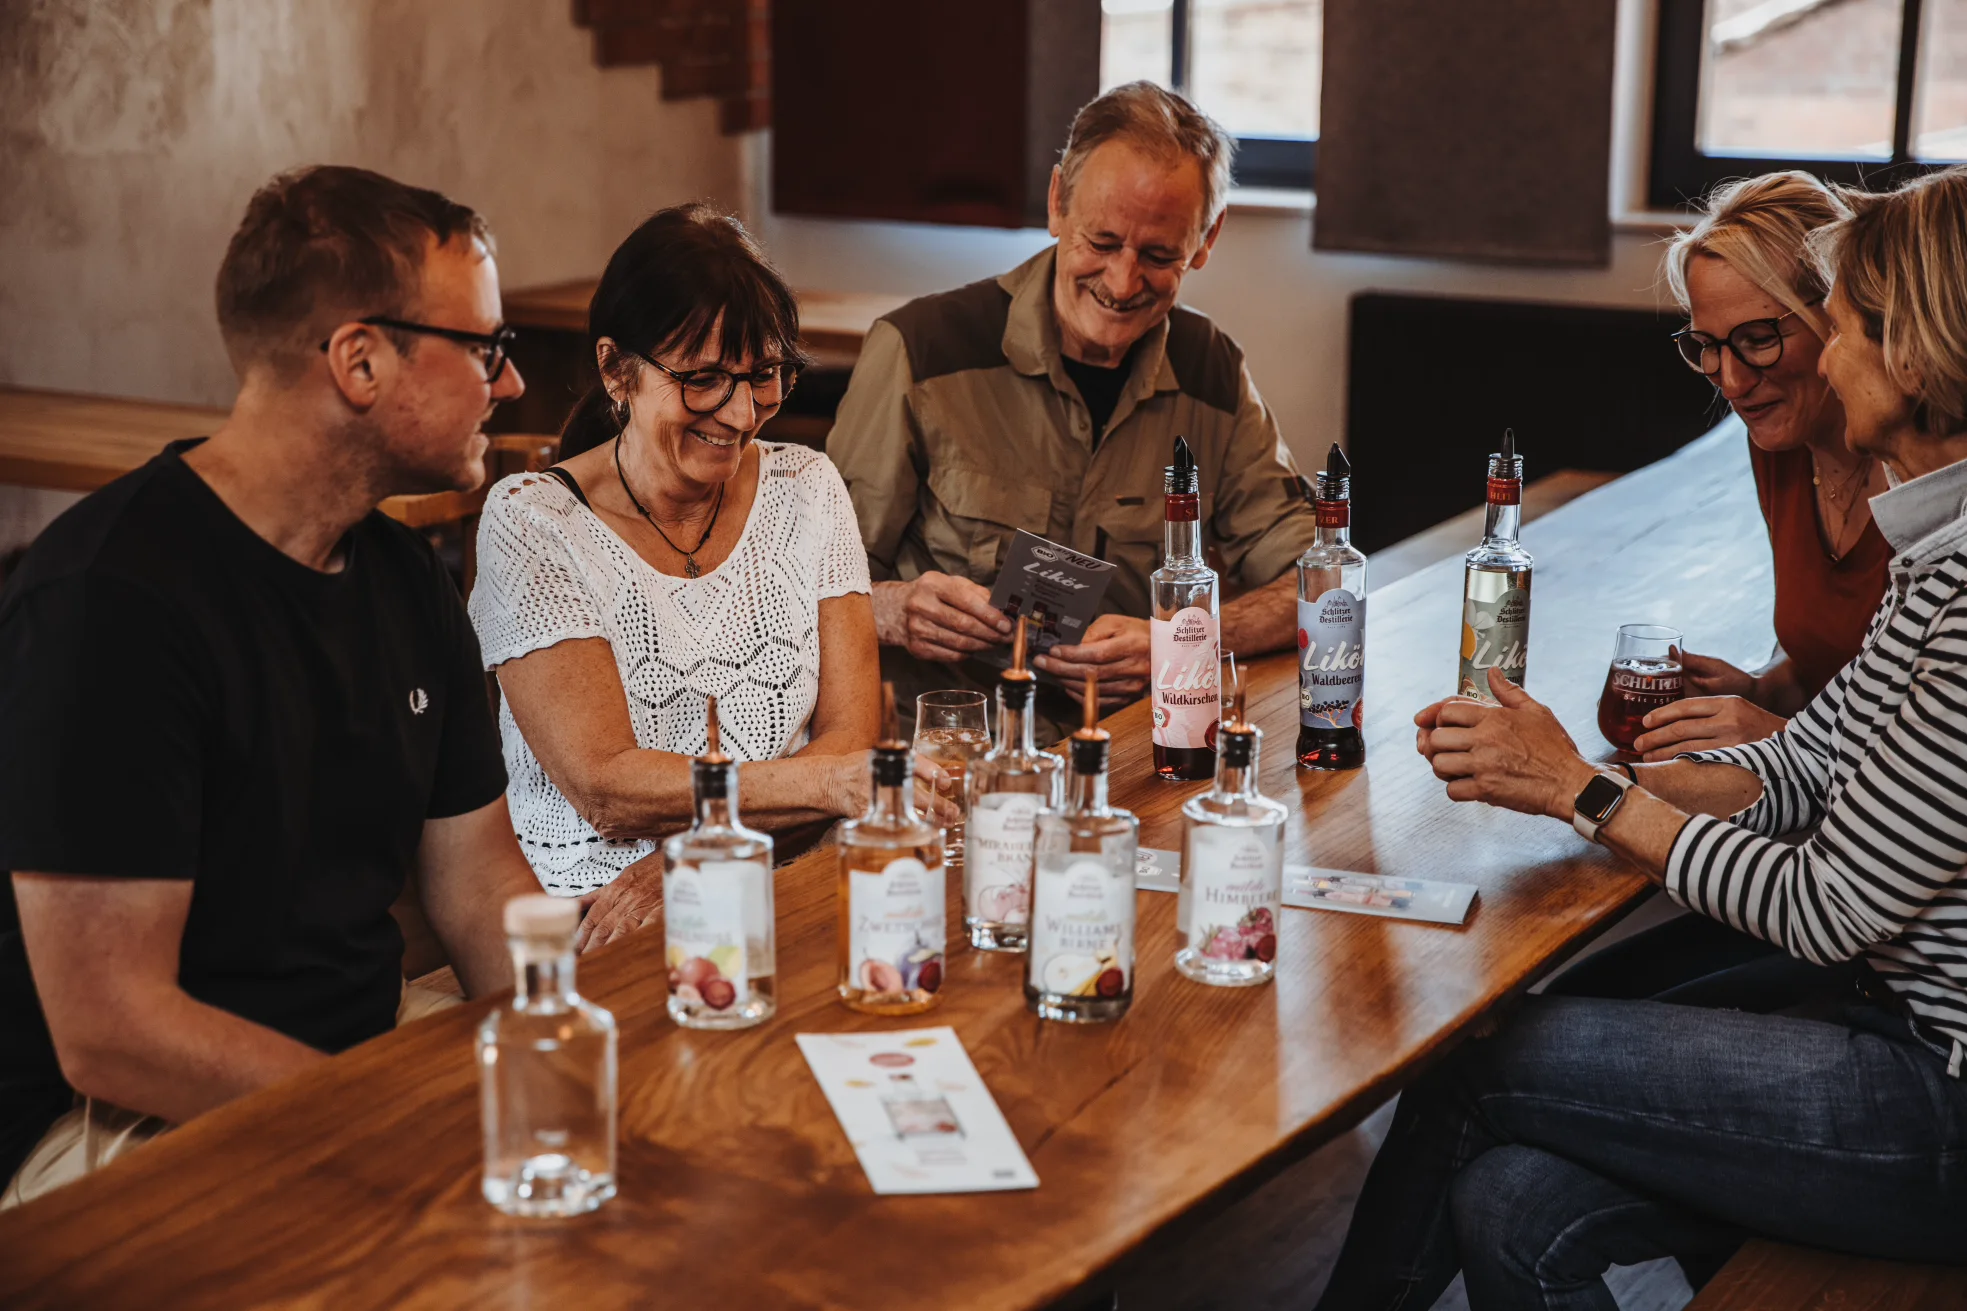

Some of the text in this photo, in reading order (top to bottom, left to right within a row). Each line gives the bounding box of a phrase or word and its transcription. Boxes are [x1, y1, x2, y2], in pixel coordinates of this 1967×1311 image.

[1065, 553, 1102, 570] NEU
[1022, 561, 1090, 590] Likör
[1321, 607, 1351, 618] Schlitzer
[1319, 615, 1354, 625] Destillerie
[1175, 626, 1206, 637] Schlitzer
[1173, 633, 1208, 643] Destillerie
[1162, 691, 1219, 706] Wildkirschen
